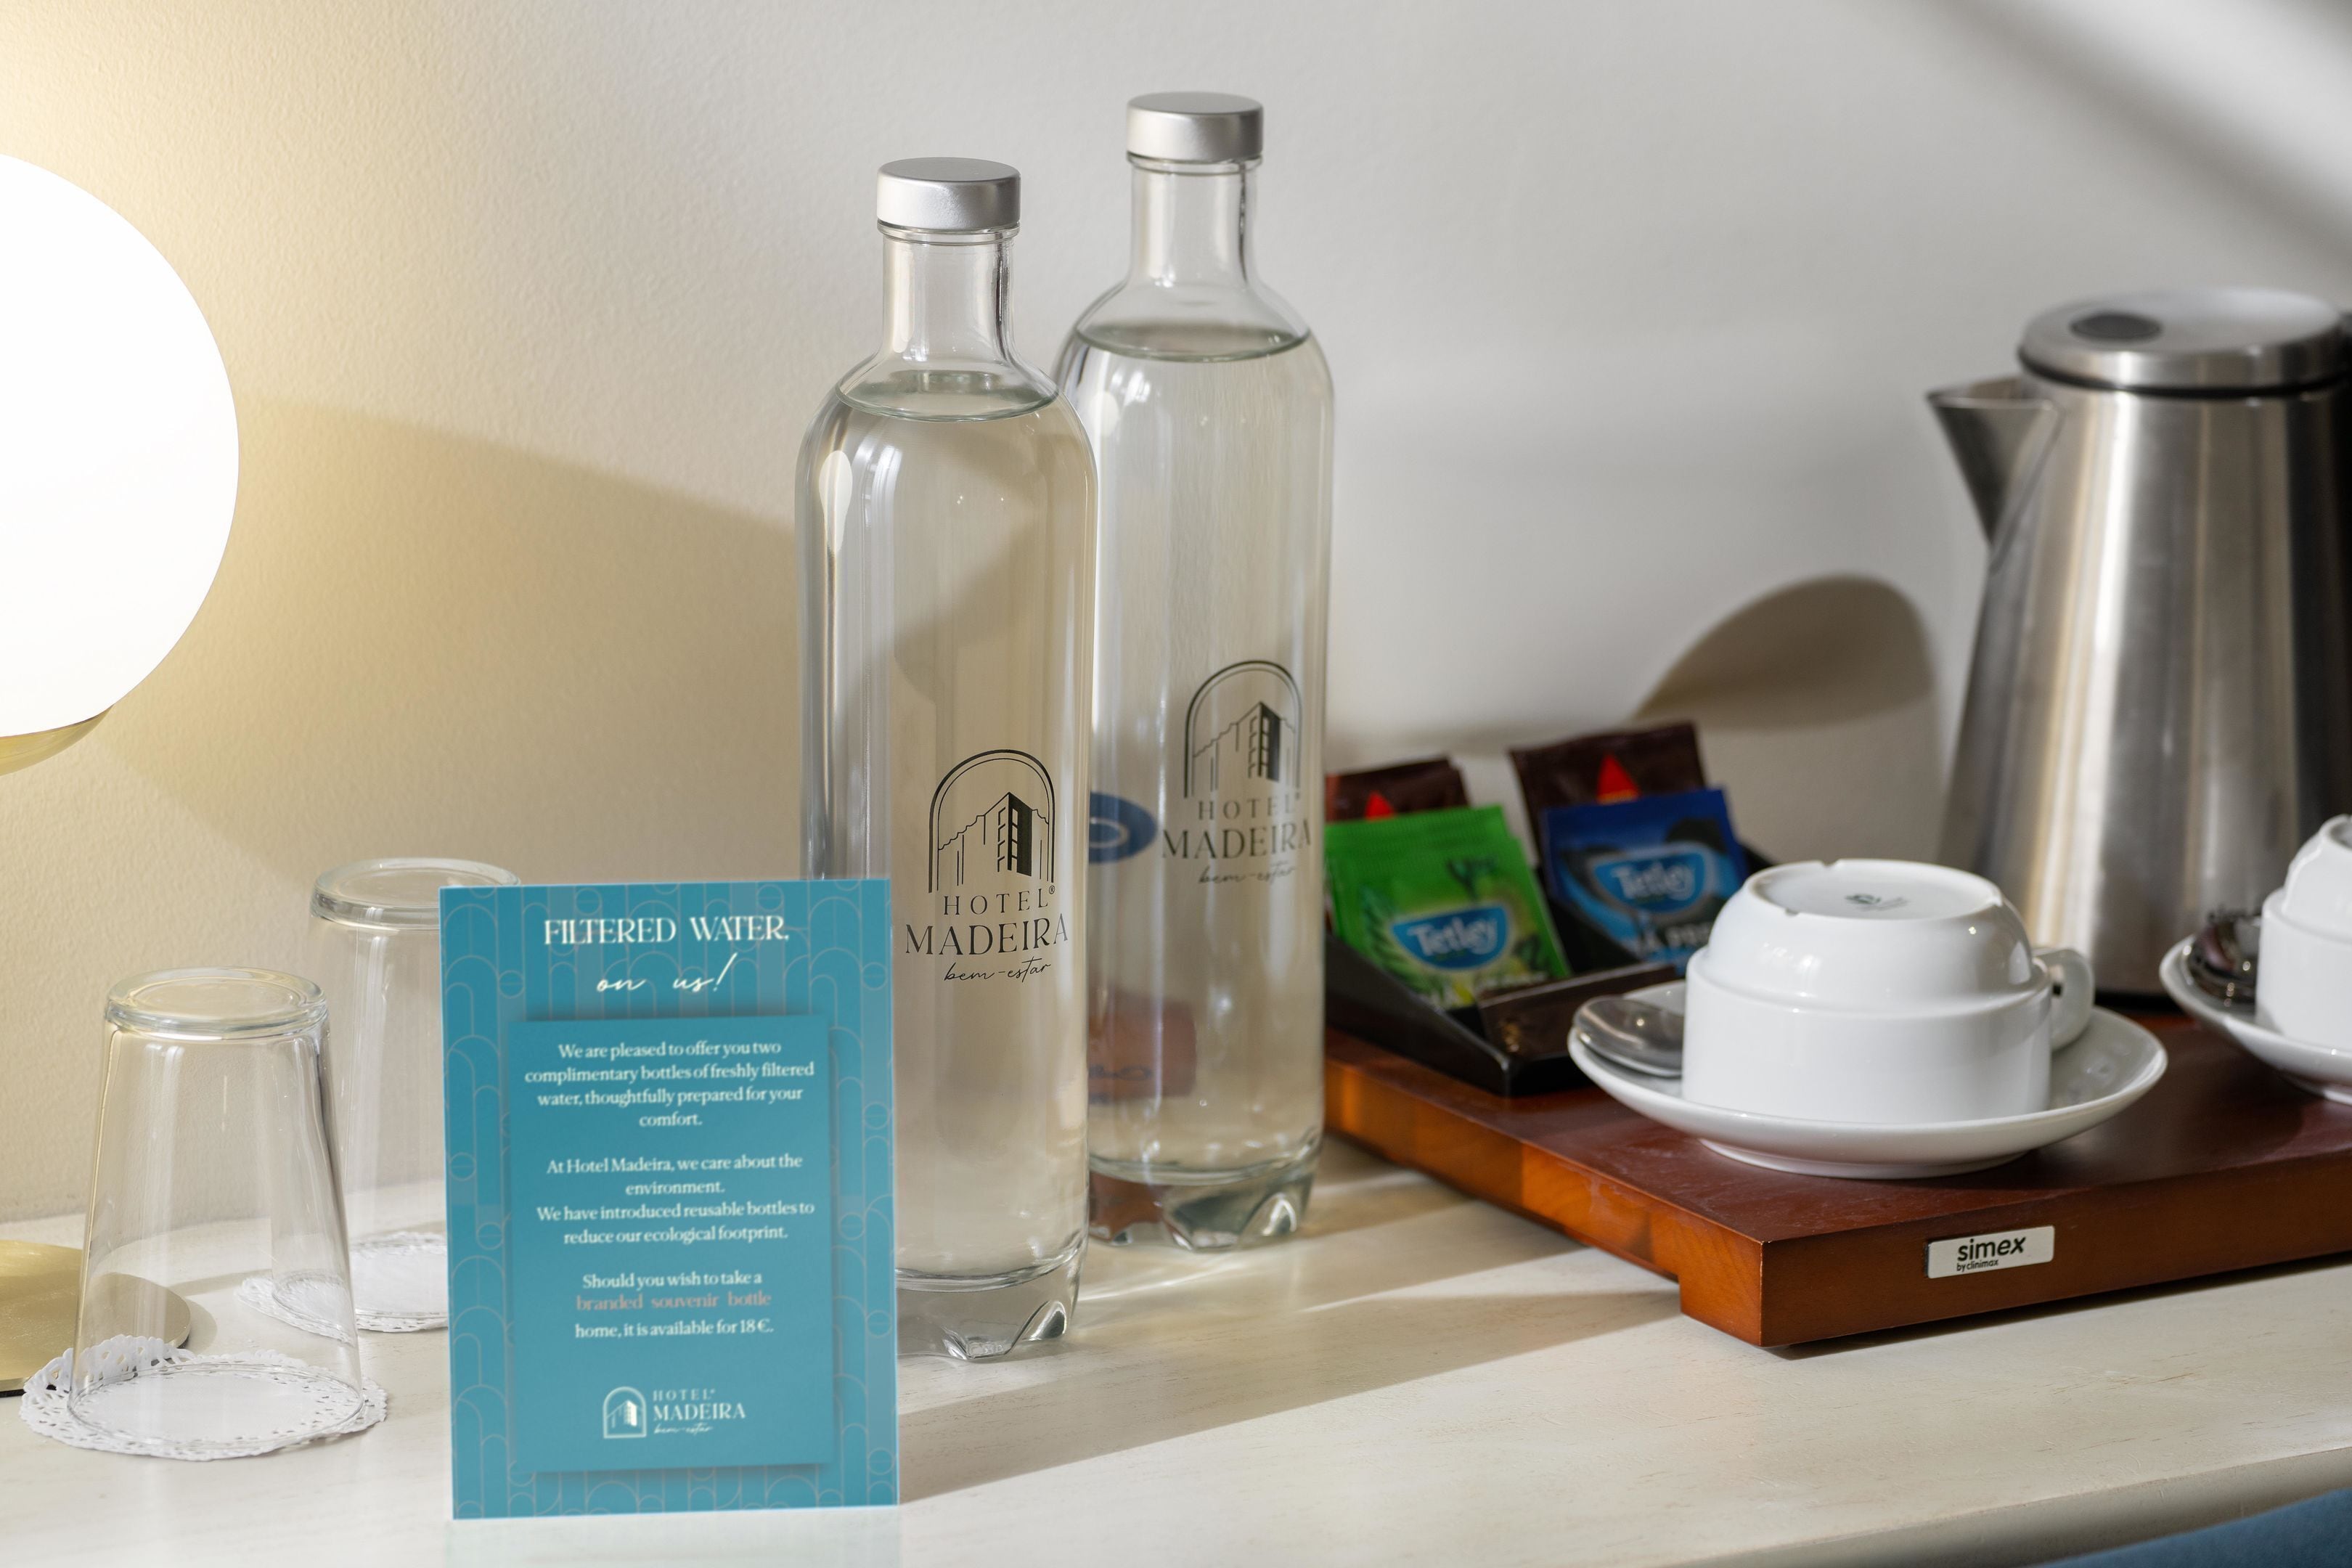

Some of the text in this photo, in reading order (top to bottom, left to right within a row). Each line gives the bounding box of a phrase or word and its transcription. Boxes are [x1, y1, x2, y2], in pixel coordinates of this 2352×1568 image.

[1161, 817, 1311, 859] MADEIRA
[1612, 861, 1694, 901] Tetley
[544, 917, 677, 945] FILTERED
[905, 912, 1069, 955] MADEIRA
[1407, 917, 1498, 956] Tetley
[596, 952, 738, 993] on us!
[944, 955, 1051, 983] bem-estar
[558, 1040, 781, 1061] We are pleased to offer you two
[524, 1061, 814, 1086] complimentary bottles of freshly filtered
[537, 1085, 804, 1108] water, thoughtfully prepared for your
[639, 1111, 703, 1127] comfort.
[547, 1153, 803, 1174] At Hotel Madeira, we care about the
[625, 1181, 725, 1196] environment.
[536, 1200, 815, 1222] We have introduced reusable bottles to
[563, 1225, 788, 1245] reduce our ecological footprint.
[1957, 1237, 2026, 1262] simex
[1956, 1259, 1998, 1272] by clinimax
[582, 1269, 764, 1291] Should you wish to take a
[576, 1289, 772, 1311] branded souvenir bottle
[575, 1323, 622, 1338] home,
[624, 1323, 636, 1336] it
[637, 1323, 649, 1336] is
[650, 1320, 714, 1336] available
[716, 1318, 739, 1334] for
[653, 1402, 746, 1421] MADEIRA
